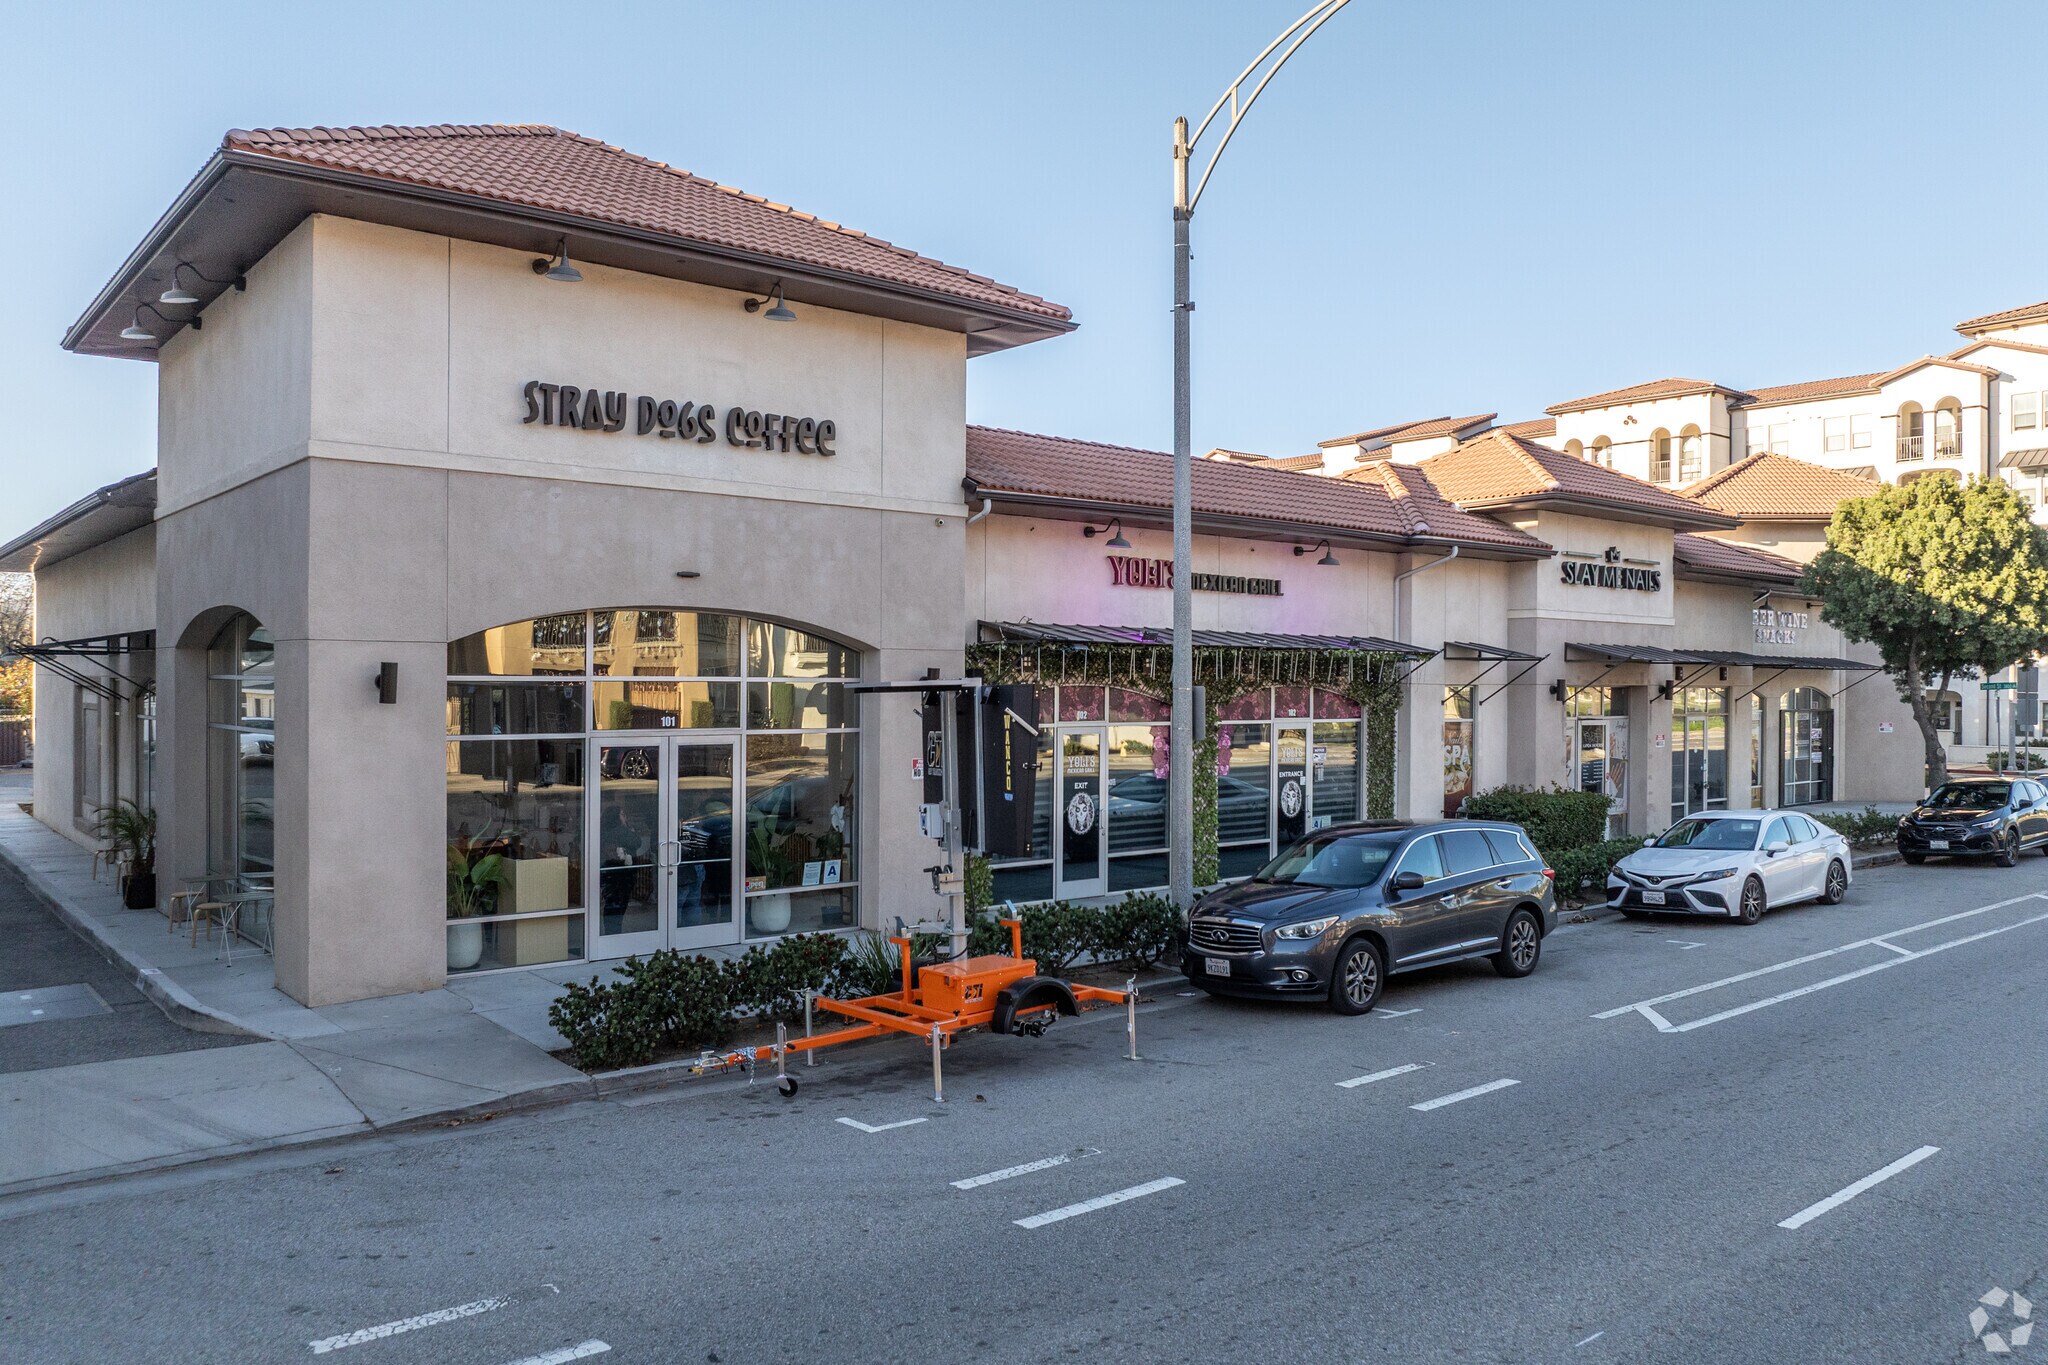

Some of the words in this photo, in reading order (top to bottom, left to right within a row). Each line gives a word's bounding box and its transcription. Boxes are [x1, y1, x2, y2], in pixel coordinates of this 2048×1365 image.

[523, 380, 627, 432] STRAY
[637, 395, 717, 443] DOGS
[1191, 572, 1247, 594] MEXICAN
[1247, 577, 1284, 597] GRILL
[1560, 561, 1599, 587] SLAY
[1599, 565, 1623, 589] ME
[1622, 567, 1661, 592] NAILS
[1752, 609, 1775, 626] EER
[1777, 611, 1808, 629] WINE
[660, 716, 676, 727] 101
[1003, 714, 1011, 791] WANCO
[1067, 755, 1096, 768] YOLI'S
[1444, 744, 1471, 767] SPA
[1278, 770, 1304, 778] ENTRANCE
[1074, 781, 1089, 790] EXIT
[827, 865, 837, 877] A
